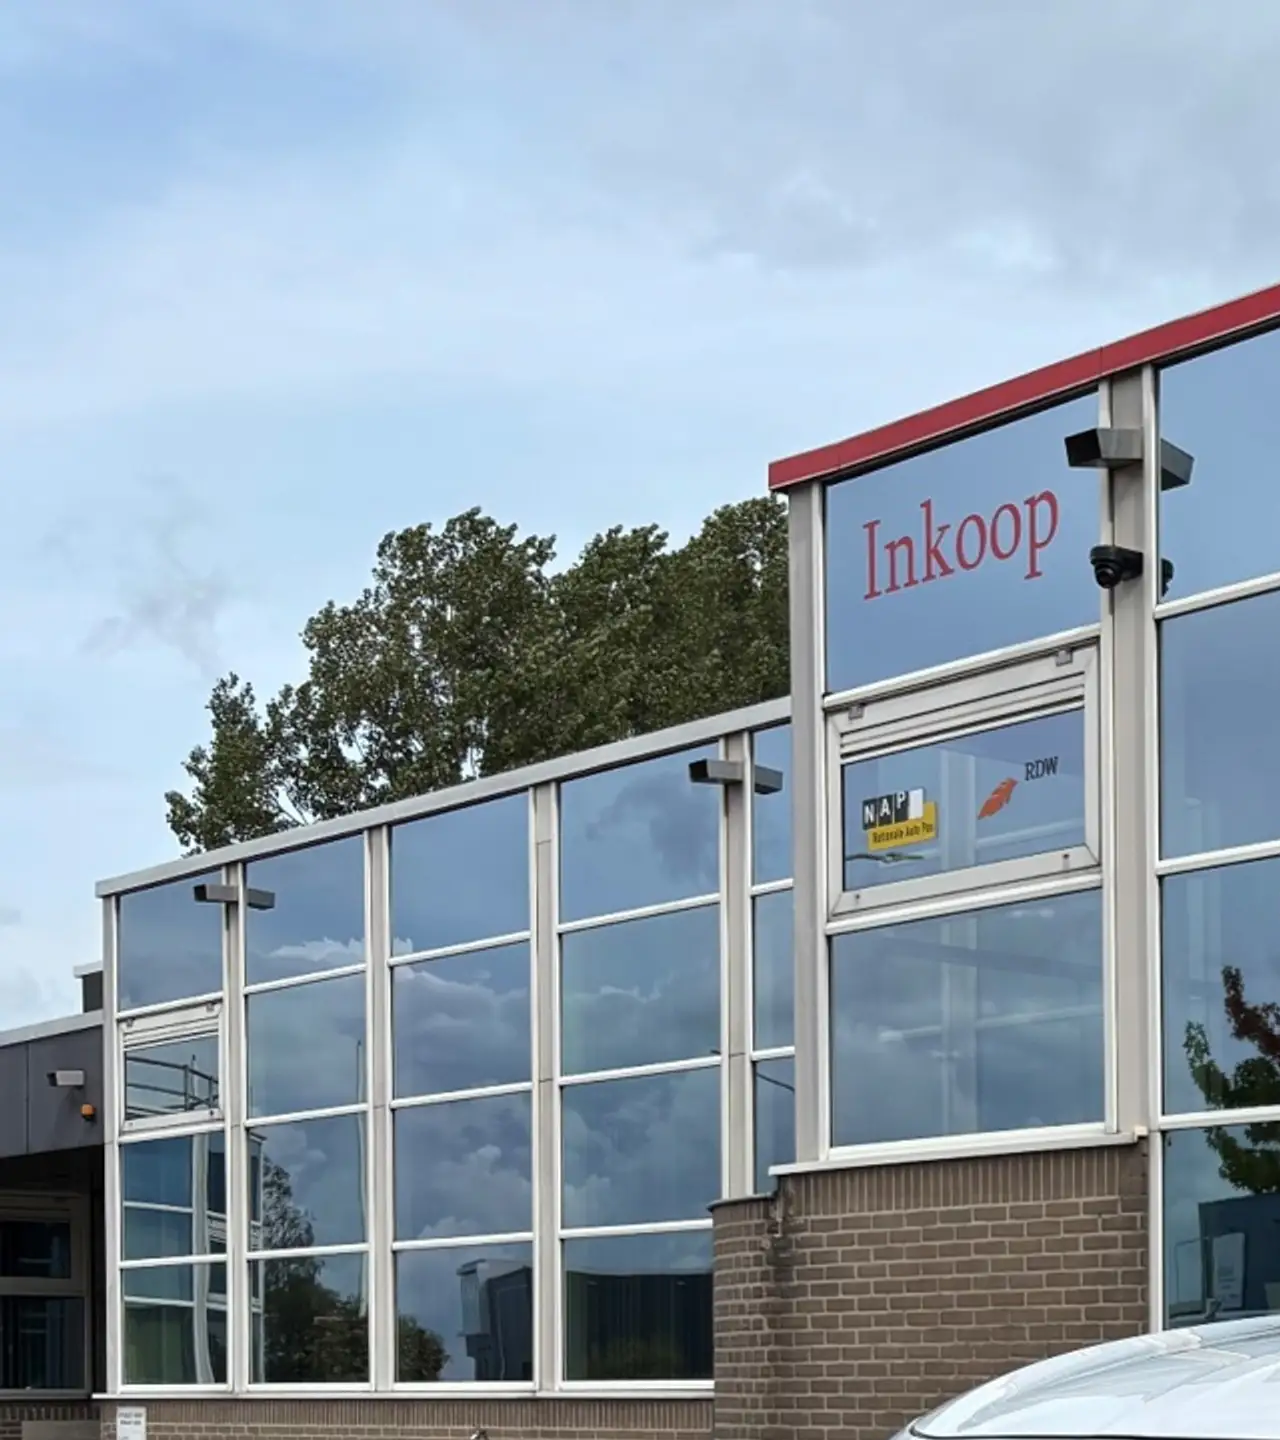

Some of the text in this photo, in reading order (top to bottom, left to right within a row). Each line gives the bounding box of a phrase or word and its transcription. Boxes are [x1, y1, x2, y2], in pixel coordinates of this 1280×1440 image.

[863, 488, 1059, 600] Inkoop
[1024, 756, 1059, 781] RDW
[863, 790, 907, 824] NAP
